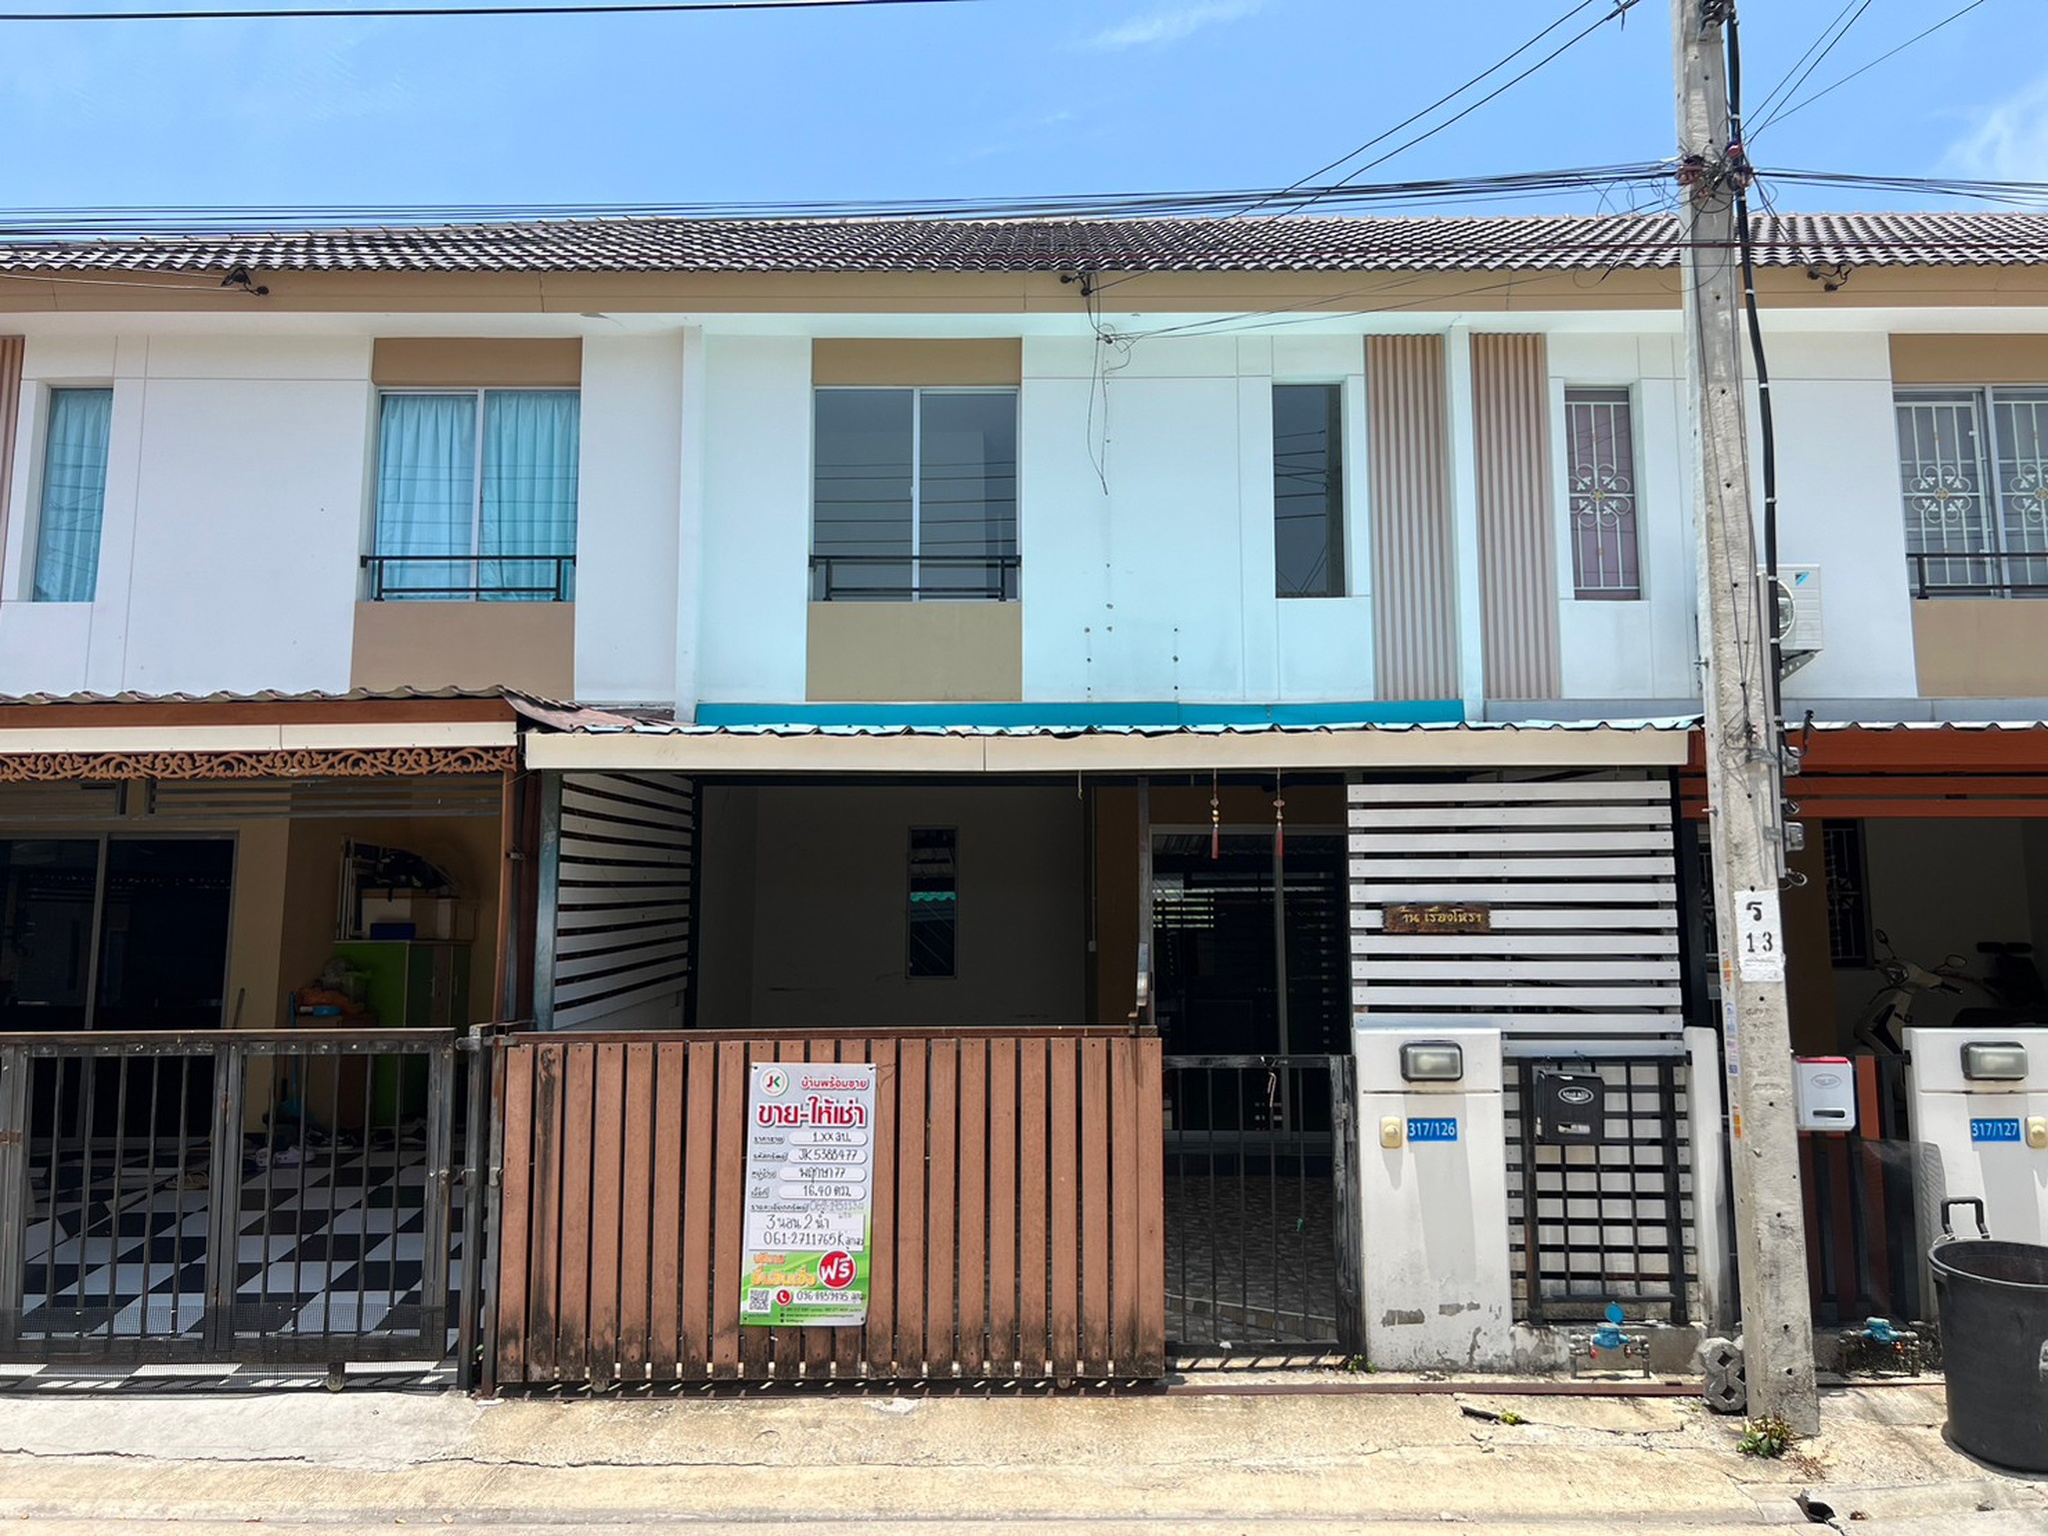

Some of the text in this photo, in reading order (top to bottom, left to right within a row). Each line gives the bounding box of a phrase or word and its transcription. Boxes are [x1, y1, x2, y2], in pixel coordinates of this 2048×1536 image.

[766, 1075, 781, 1088] JK
[758, 1096, 865, 1124] ขาย-ให้เช่า
[1408, 1121, 1456, 1137] 317/126
[1971, 1122, 2018, 1137] 317/127
[820, 1254, 850, 1281] ฟรี
